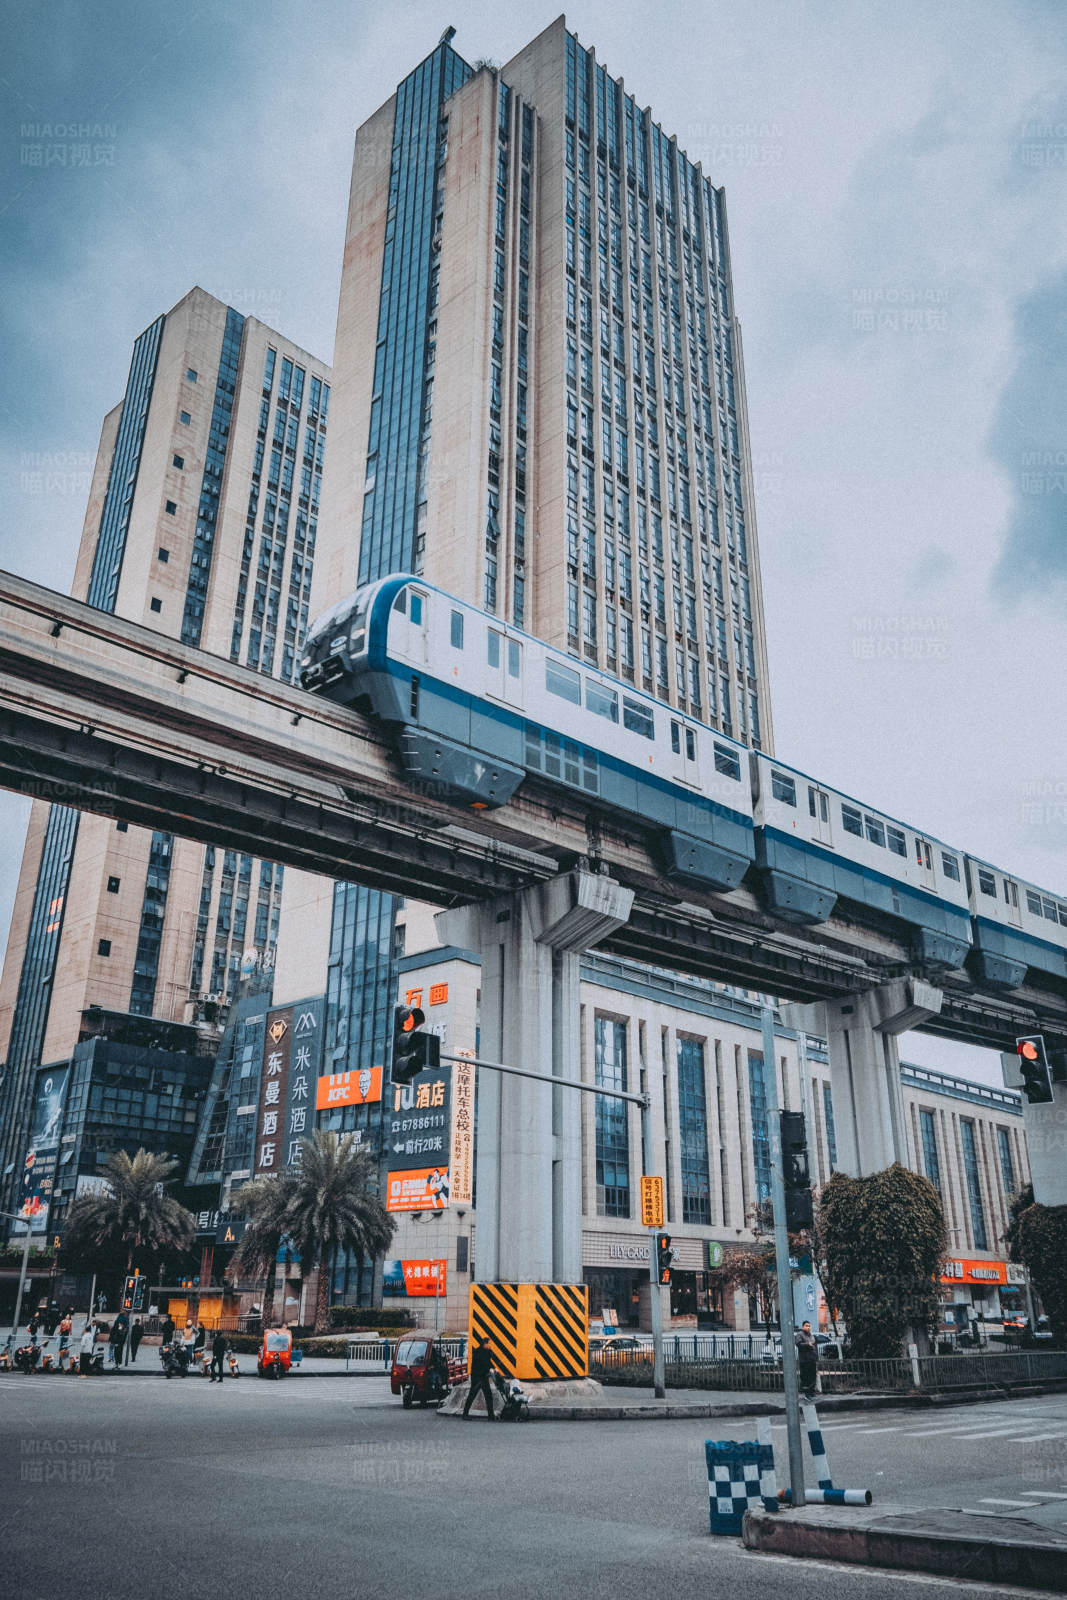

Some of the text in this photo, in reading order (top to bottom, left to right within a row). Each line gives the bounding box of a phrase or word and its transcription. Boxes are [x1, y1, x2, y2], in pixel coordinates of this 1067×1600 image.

[259, 1052, 284, 1168] 东曼酒店
[287, 1046, 311, 1166] 米朵酒店
[327, 1086, 351, 1102] KFC
[405, 1136, 442, 1155] 前行20米
